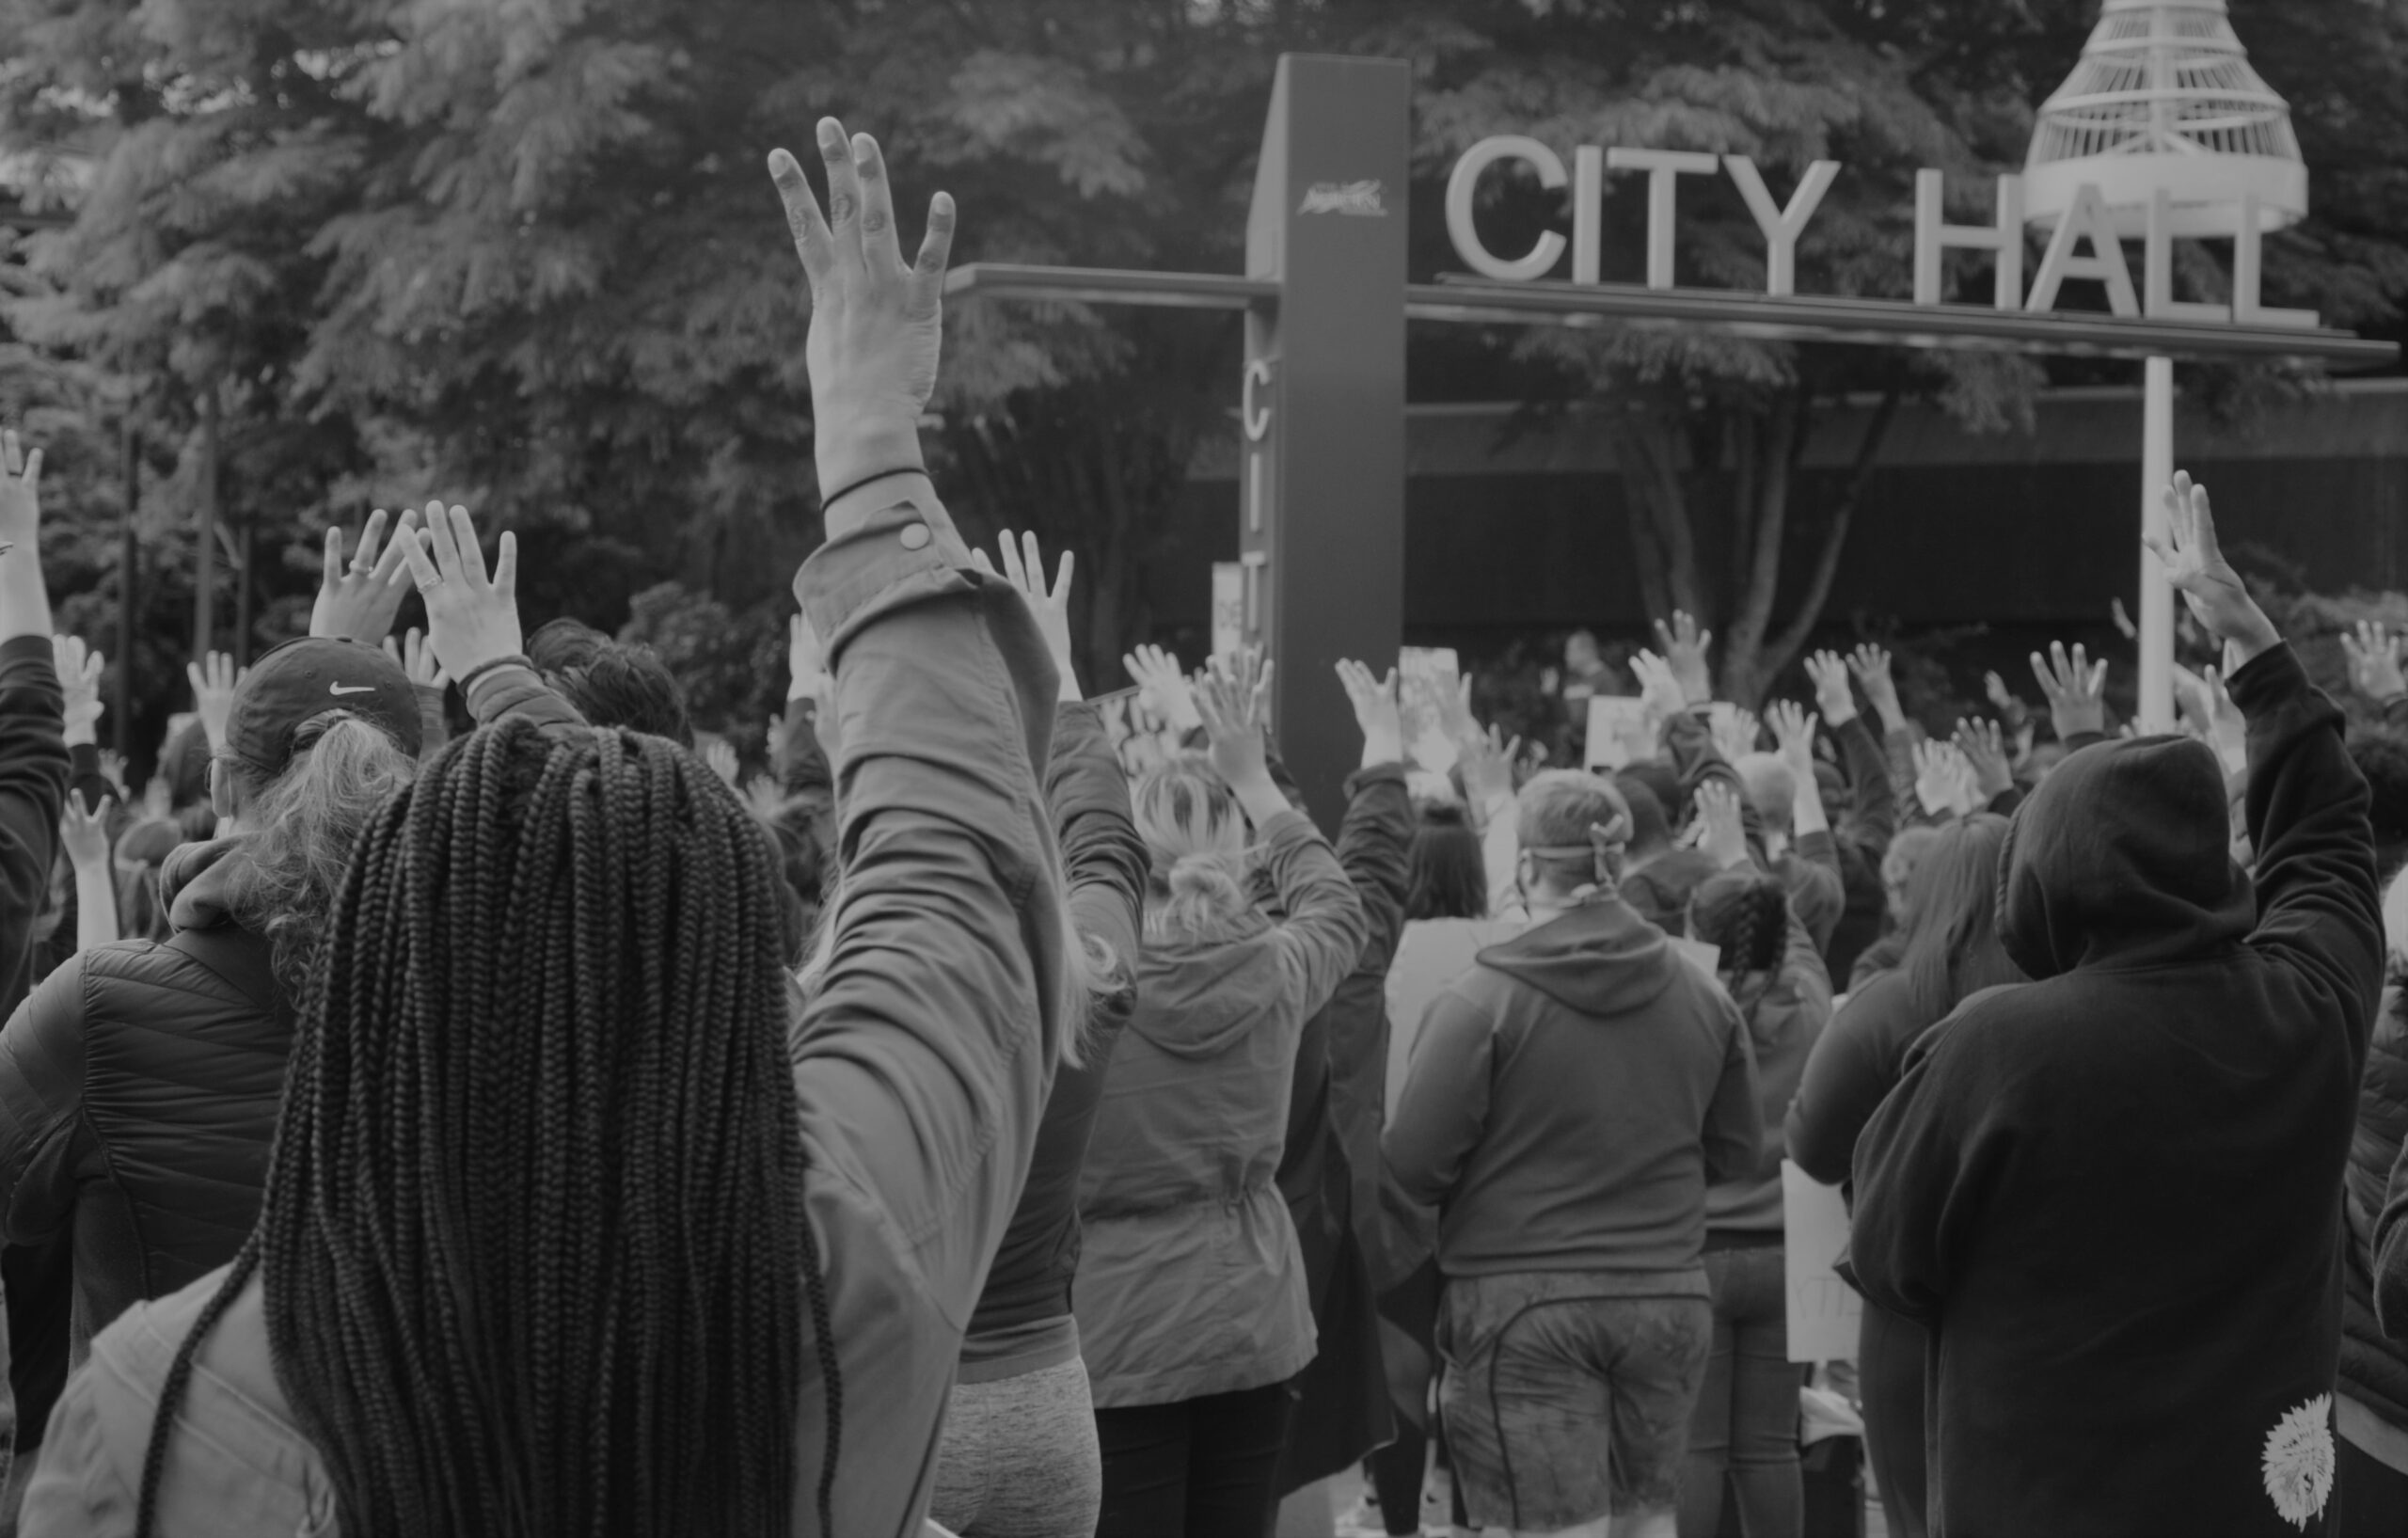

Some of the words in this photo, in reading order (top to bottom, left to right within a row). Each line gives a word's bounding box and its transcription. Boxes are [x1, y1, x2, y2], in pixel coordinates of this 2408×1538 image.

[1445, 135, 1841, 296] CITY
[1914, 168, 2320, 328] HALL
[1241, 358, 1271, 657] CIT
